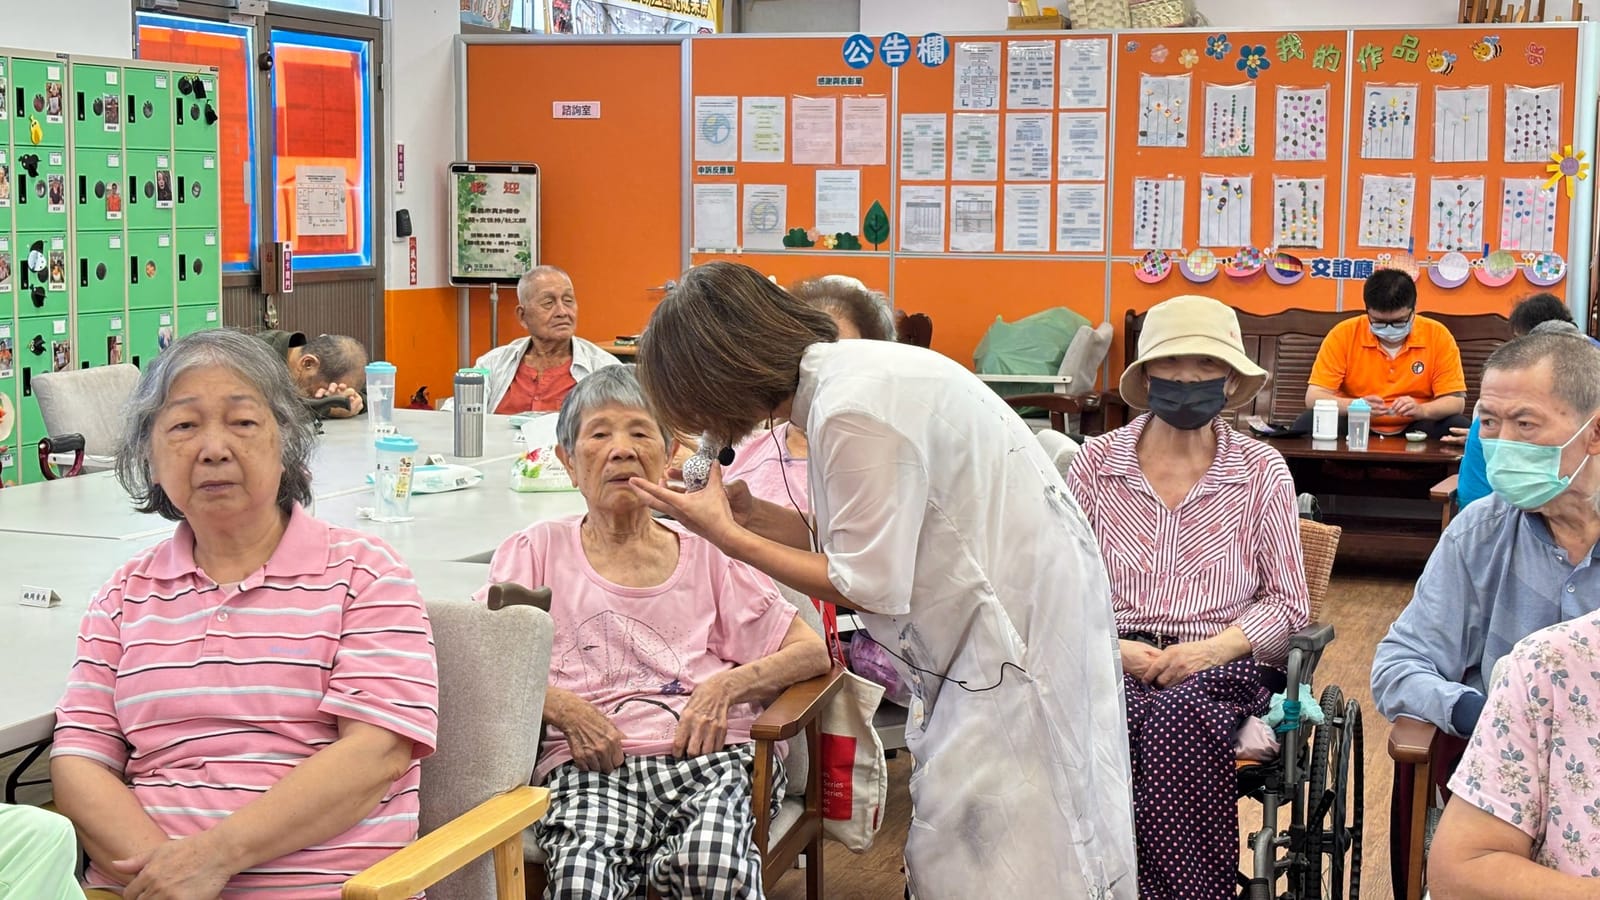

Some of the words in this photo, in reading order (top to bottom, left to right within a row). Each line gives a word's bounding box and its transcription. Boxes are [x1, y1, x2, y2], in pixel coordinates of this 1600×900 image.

[844, 34, 945, 64] 公告欄
[1276, 32, 1420, 73] 我的作品
[562, 104, 592, 116] 諮詢室
[1311, 258, 1373, 279] 交誼廳
